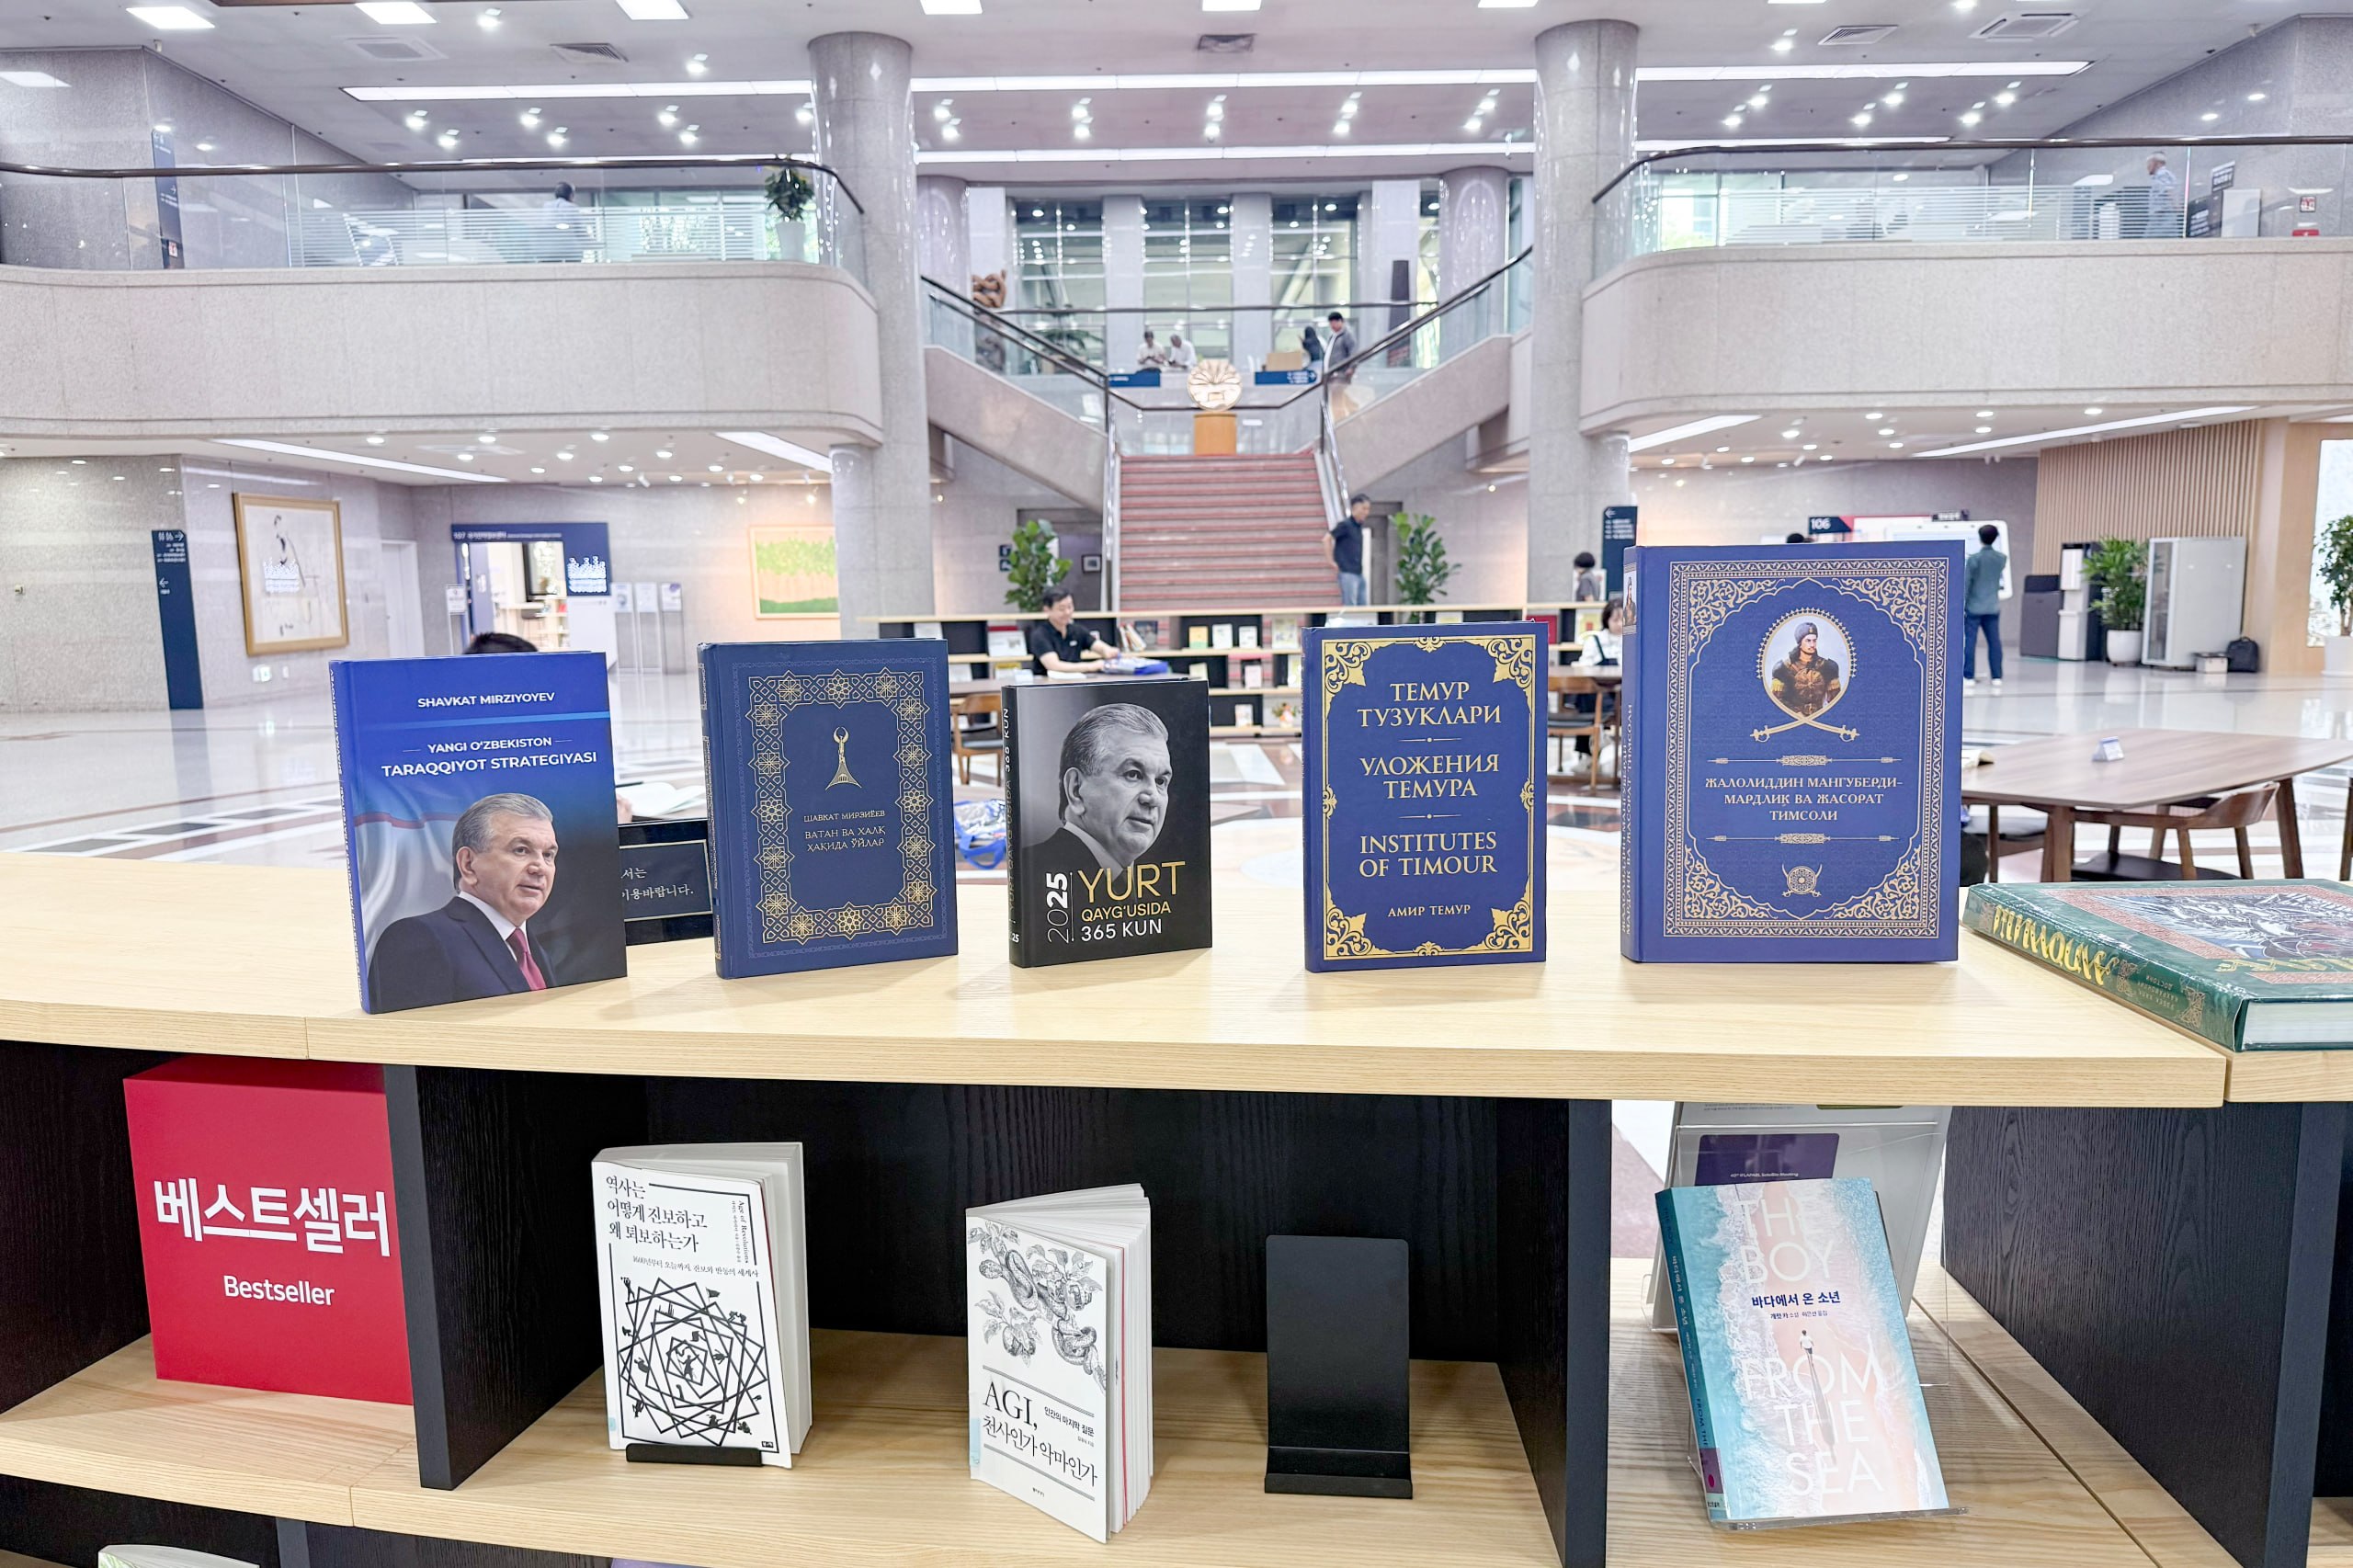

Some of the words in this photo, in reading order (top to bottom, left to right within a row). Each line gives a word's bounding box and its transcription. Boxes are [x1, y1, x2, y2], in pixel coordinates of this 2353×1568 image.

[1811, 517, 1831, 529] 106
[417, 696, 477, 708] SHAVKAT
[480, 692, 555, 705] MIRZIYOYEV
[1390, 681, 1470, 701] ТЕМУР
[1357, 705, 1502, 728] ТУЗУКЛАРИ
[427, 742, 467, 754] YANGI
[381, 758, 487, 778] TARAQQIYOT
[491, 751, 597, 769] STRATEGIYASI
[1359, 754, 1500, 777] УЛОЖЕНИЯ
[1383, 778, 1478, 800] ТЕМУРА
[1705, 778, 1803, 790] ЖАЛОЛИДДИН
[1724, 794, 1790, 806] МАРДЛИК
[1794, 794, 1813, 804] ВА
[1817, 794, 1884, 804] ЖАСОРАТ
[803, 812, 839, 823] ШАВКАТ
[1768, 811, 1837, 821] ТИМСОЛИ
[805, 829, 838, 839] ВАТАН
[842, 828, 855, 836] ВА
[1359, 831, 1497, 854] INSTITUTES
[1358, 858, 1390, 878] OF
[1397, 855, 1498, 876] TIMOUR
[1077, 860, 1186, 903] YURT
[1046, 872, 1069, 943] 2025
[1388, 906, 1425, 917] АМИР
[1429, 904, 1472, 916] ТЕМУР
[1081, 923, 1116, 942] 365
[1122, 918, 1163, 937] KUN
[606, 1175, 646, 1199] 역사는
[154, 1177, 391, 1256] 베스트셀러
[608, 1199, 645, 1222] 어떻게
[648, 1206, 708, 1229] 진보하고
[740, 1215, 746, 1223] of
[1734, 1197, 1822, 1237] THE
[608, 1221, 621, 1240] 왜
[625, 1224, 699, 1253] 퇴보하는가
[741, 1225, 749, 1264] Revolutions
[1741, 1241, 1834, 1284] BOY
[223, 1275, 335, 1305] Bestseller
[1672, 1256, 1683, 1291] 바다에서
[1680, 1308, 1688, 1325] 소년
[1751, 1293, 1799, 1308] 바다에서
[1802, 1292, 1814, 1305] 온
[1818, 1290, 1841, 1303] 소년
[1738, 1351, 1881, 1401] FROM
[983, 1381, 1038, 1430] AGI,
[1696, 1398, 1707, 1427] FROM
[1044, 1406, 1061, 1422] 인간의
[1063, 1415, 1080, 1431] 마지막
[1082, 1425, 1094, 1437] 질문
[1773, 1401, 1870, 1447] THE
[983, 1415, 1038, 1457] 천사인가
[1040, 1442, 1098, 1487] 악마인가
[1787, 1449, 1885, 1496] SEA
